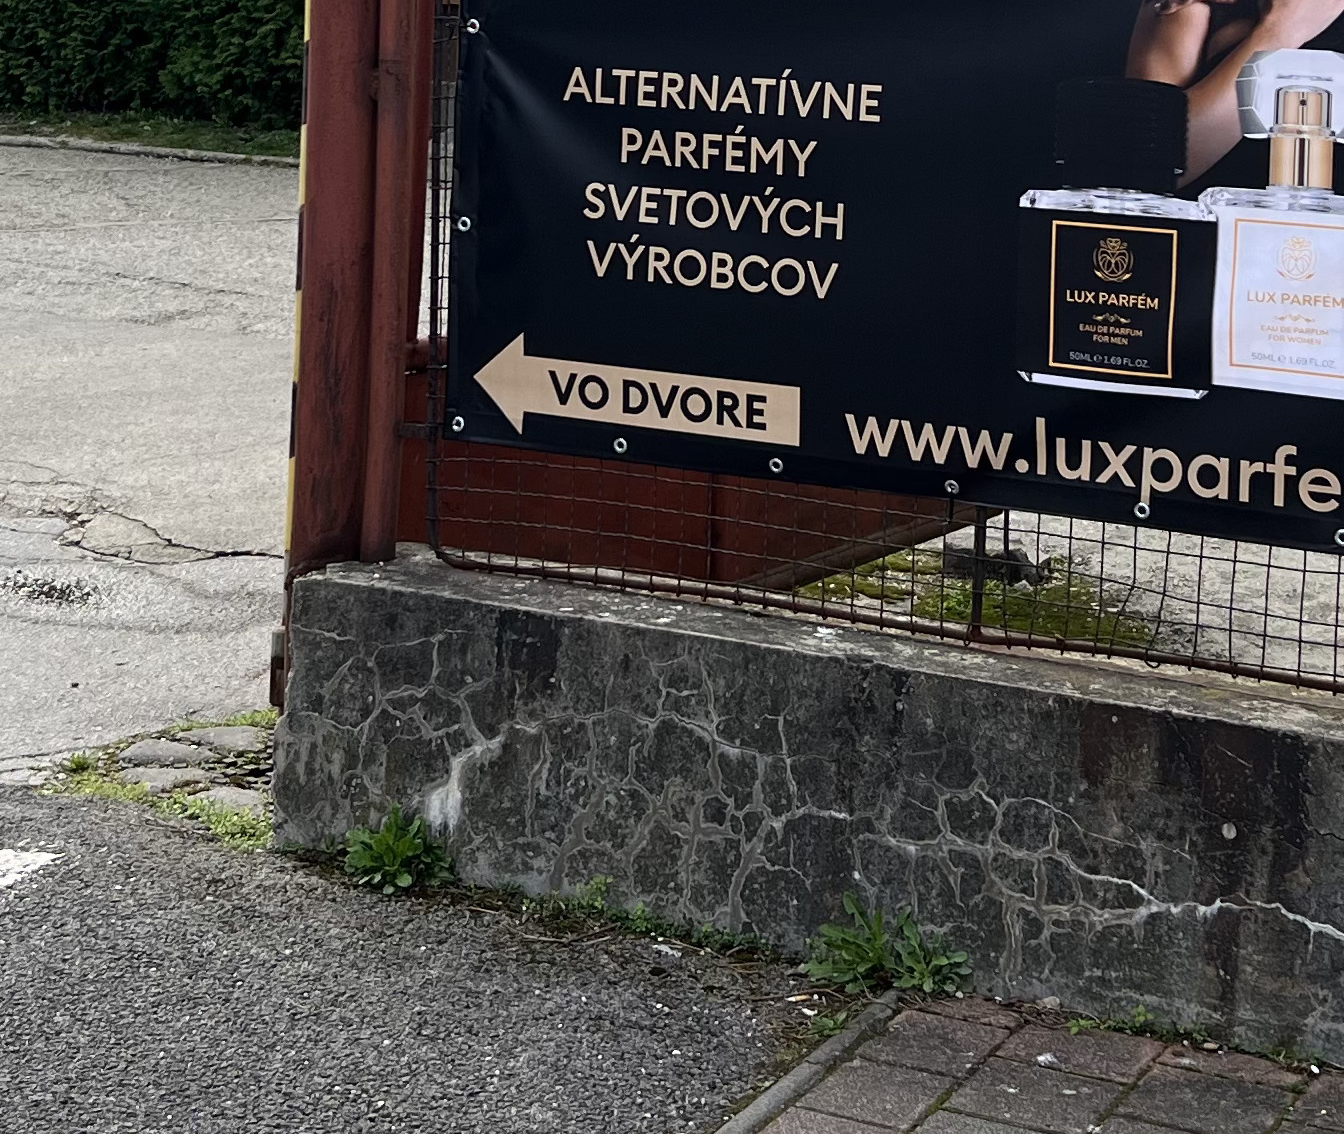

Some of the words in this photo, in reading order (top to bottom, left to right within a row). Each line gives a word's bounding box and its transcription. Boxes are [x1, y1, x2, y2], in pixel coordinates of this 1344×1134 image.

[563, 67, 882, 122] ALTERNATÍVNE
[620, 125, 817, 177] PARFÉMY
[583, 183, 844, 240] SVETOVÝCH
[587, 234, 838, 298] VÝROBCOV
[1066, 289, 1095, 304] LUX
[1098, 293, 1159, 310] PARFÉM
[1247, 290, 1276, 304] LUX
[1281, 293, 1344, 309] PARFÉM
[1079, 323, 1096, 332] EAU
[1097, 325, 1108, 333] DE
[1109, 327, 1143, 337] PARFUM
[1093, 334, 1110, 343] FOR
[1111, 336, 1128, 345] MEN
[1260, 324, 1278, 332] EAU
[1293, 327, 1329, 336] PARFUM
[1268, 334, 1285, 342] FOR
[1287, 336, 1321, 345] WOMEN
[1069, 351, 1092, 362] 50ML
[1104, 356, 1122, 365] 1.69
[1251, 352, 1276, 362] 50ML
[548, 370, 609, 410] VO
[622, 379, 768, 431] DVORE
